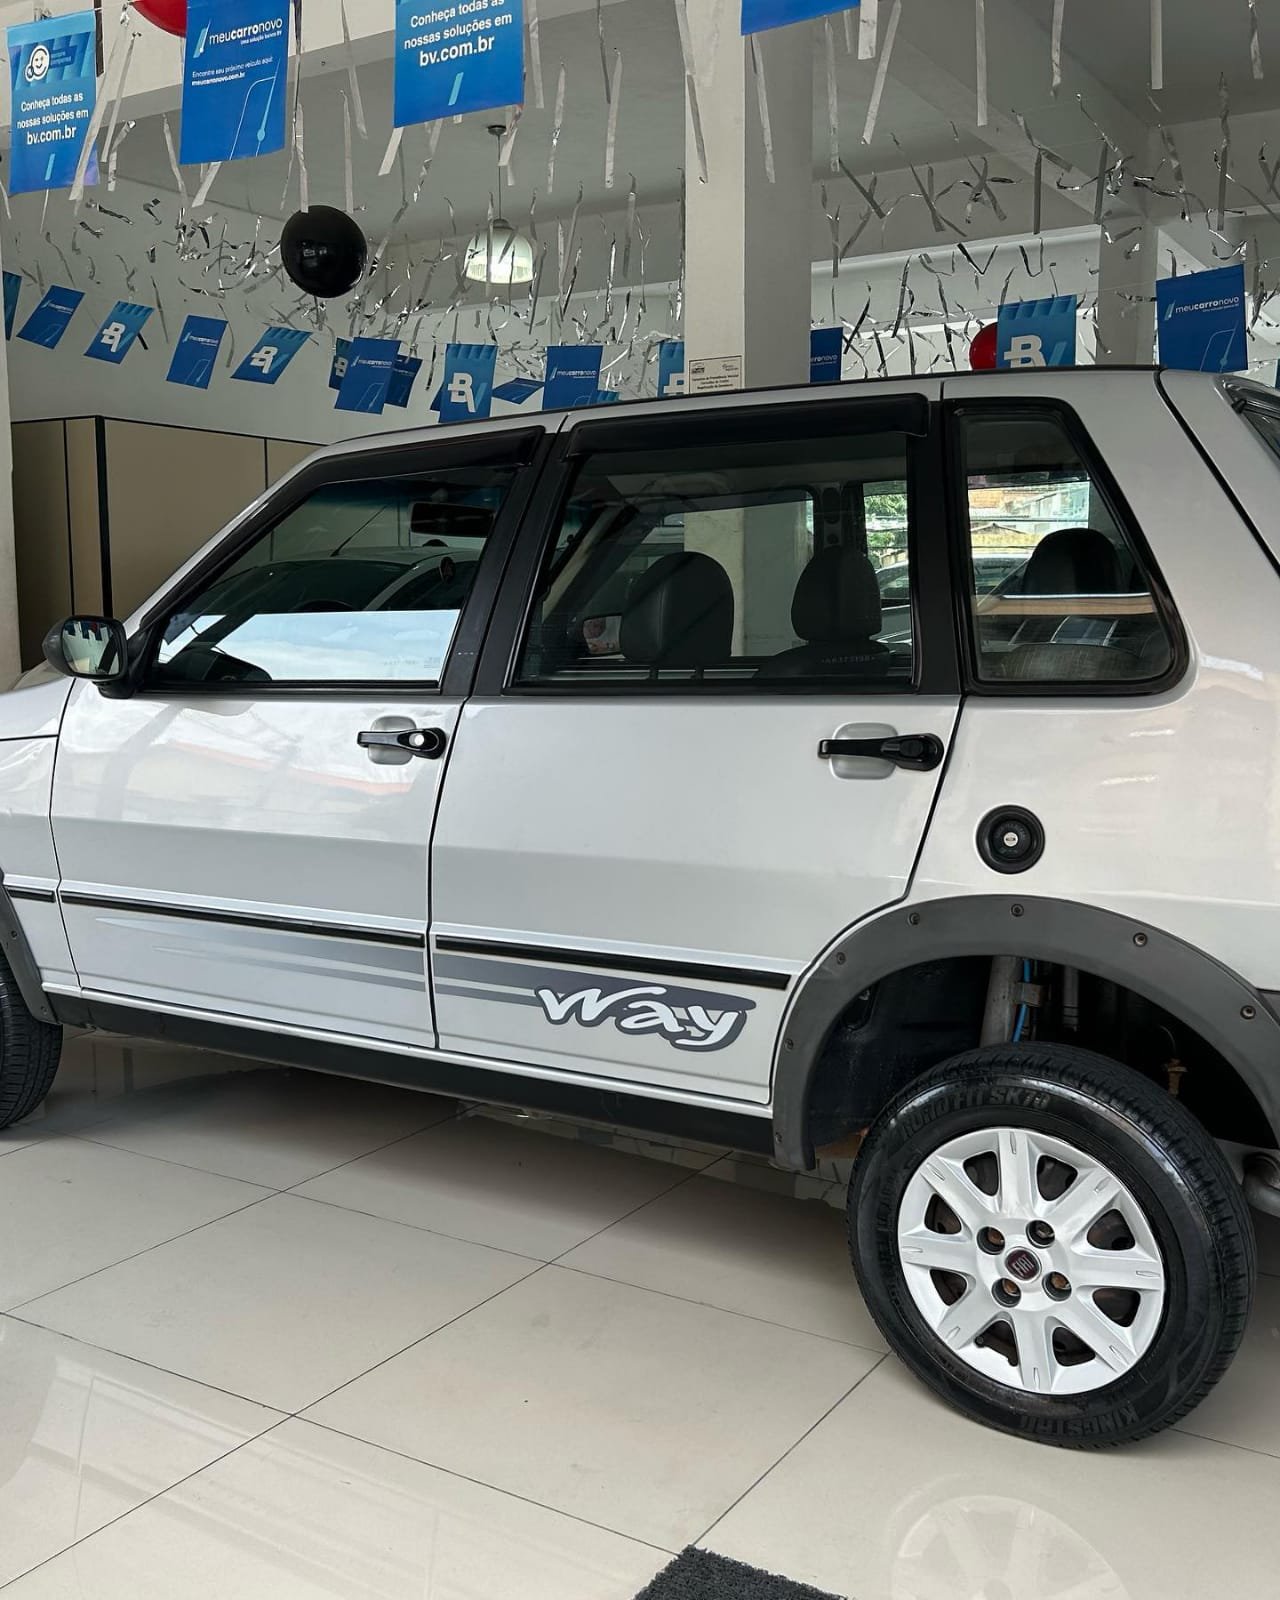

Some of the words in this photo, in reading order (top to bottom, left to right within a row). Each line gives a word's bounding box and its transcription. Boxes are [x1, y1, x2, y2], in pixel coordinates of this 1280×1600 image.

[410, 7, 456, 28] Conheça
[458, 0, 488, 15] todas
[404, 31, 441, 49] nossas
[443, 18, 492, 39] soluções
[494, 13, 513, 27] em
[419, 35, 495, 67] bv.com.br
[21, 98, 50, 112] Conheça
[51, 93, 72, 106] todas
[74, 92, 83, 101] as
[17, 118, 40, 129] nossas
[42, 111, 74, 124] soluções
[76, 109, 89, 119] em
[26, 124, 77, 145] bv.com.br
[1011, 1253, 1035, 1277] FIAT
